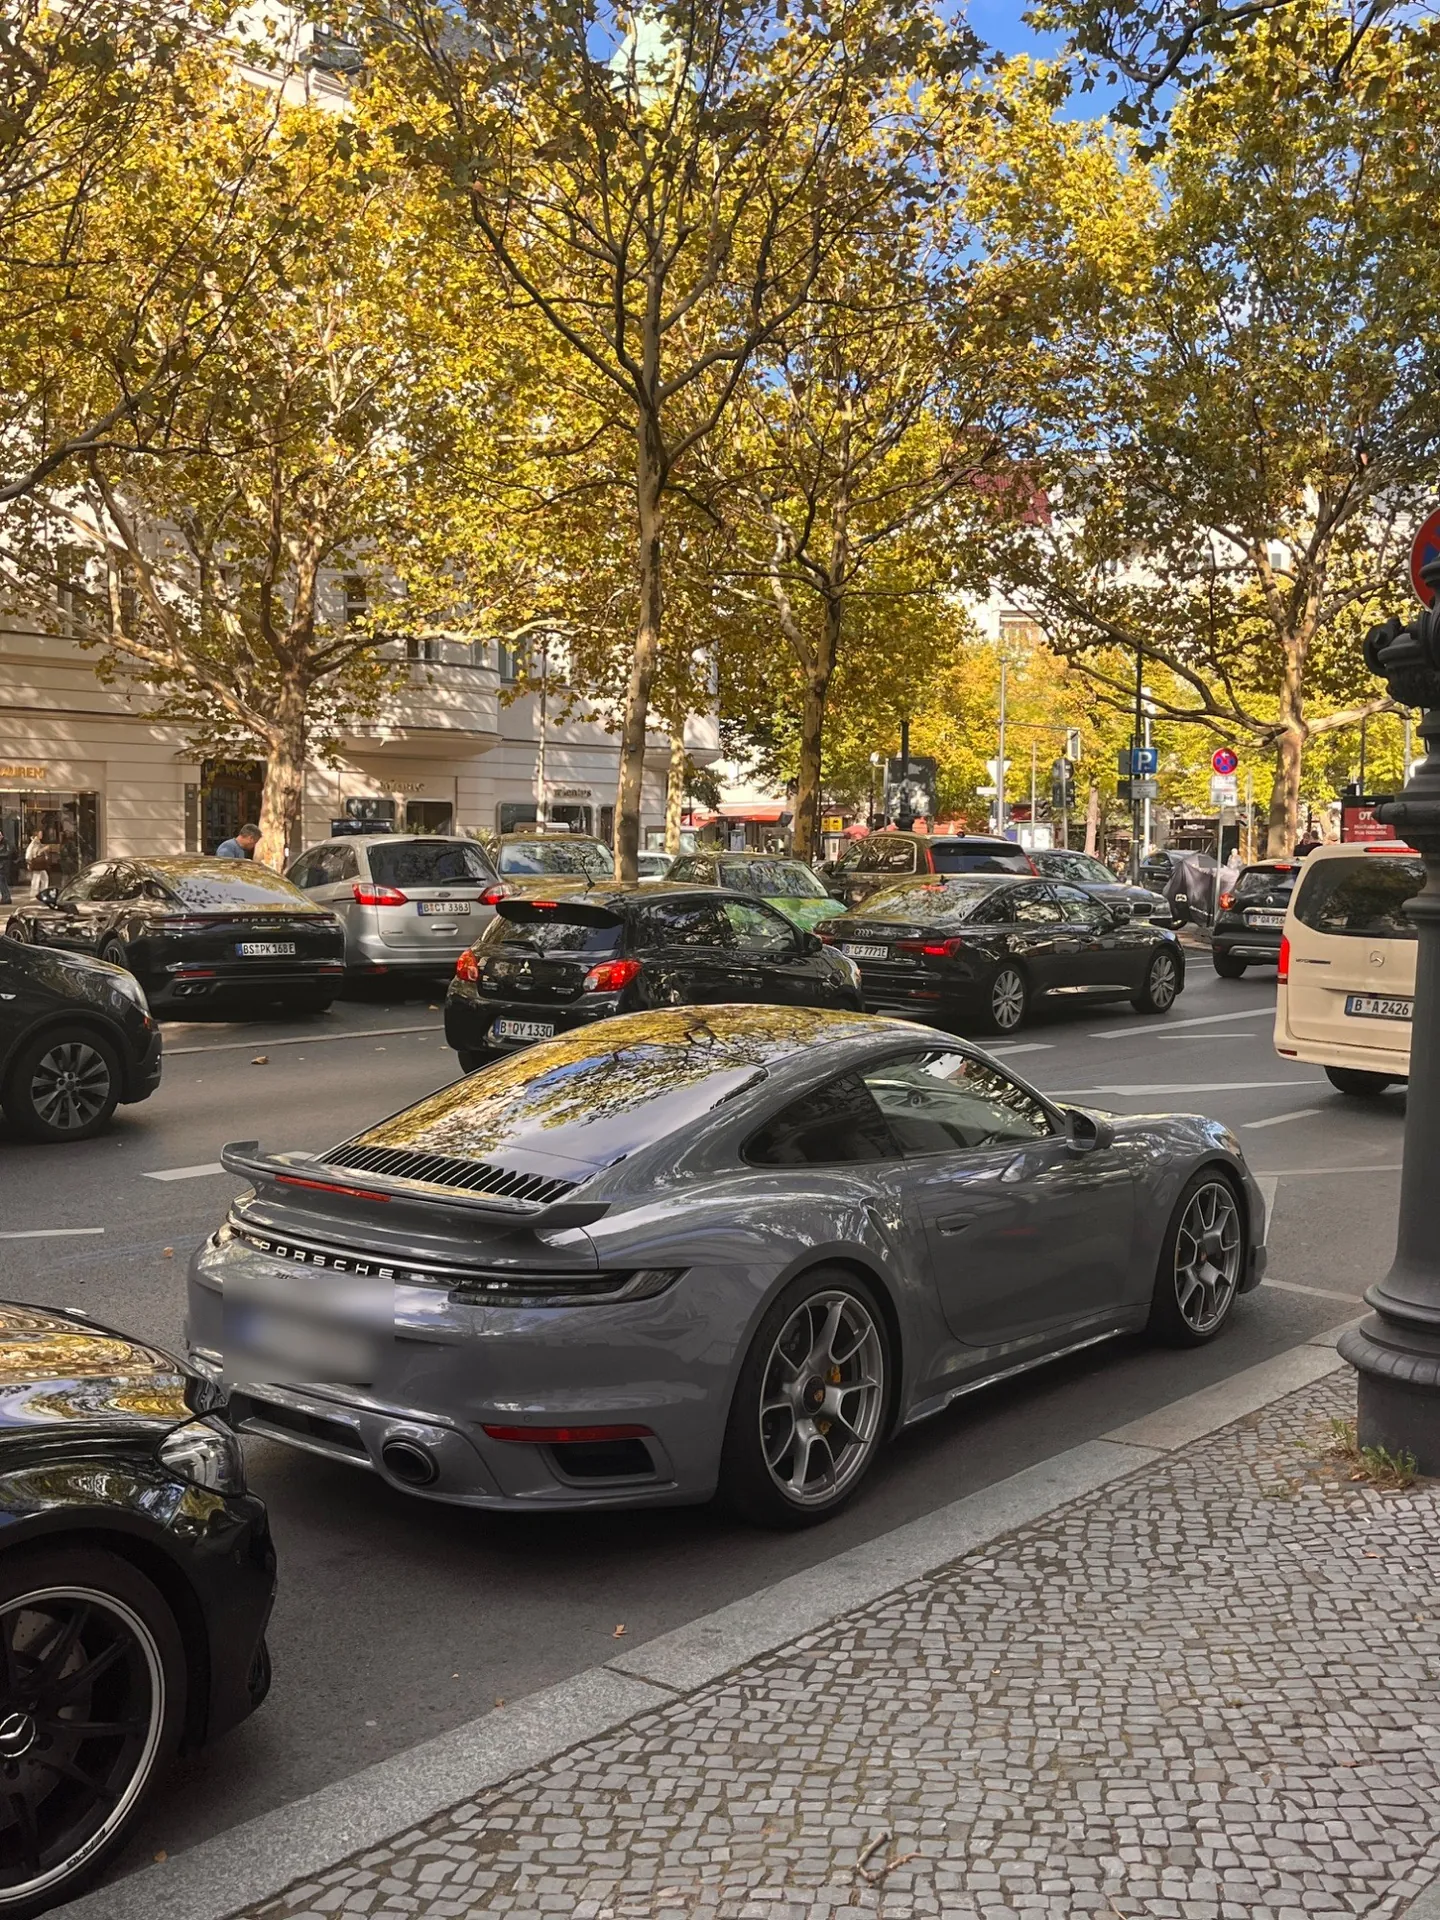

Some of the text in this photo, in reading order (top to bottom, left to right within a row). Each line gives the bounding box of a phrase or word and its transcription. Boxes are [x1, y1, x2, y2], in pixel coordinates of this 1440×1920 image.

[1138, 751, 1152, 771] P
[0, 767, 47, 778] AURENT
[434, 904, 446, 912] CT
[243, 944, 255, 954] BS
[260, 944, 271, 953] PK
[1355, 1000, 1362, 1011] B
[1381, 1002, 1409, 1015] 2426
[500, 1021, 507, 1034] B
[527, 1025, 553, 1038] 1330
[259, 1241, 395, 1280] PORSCHE
